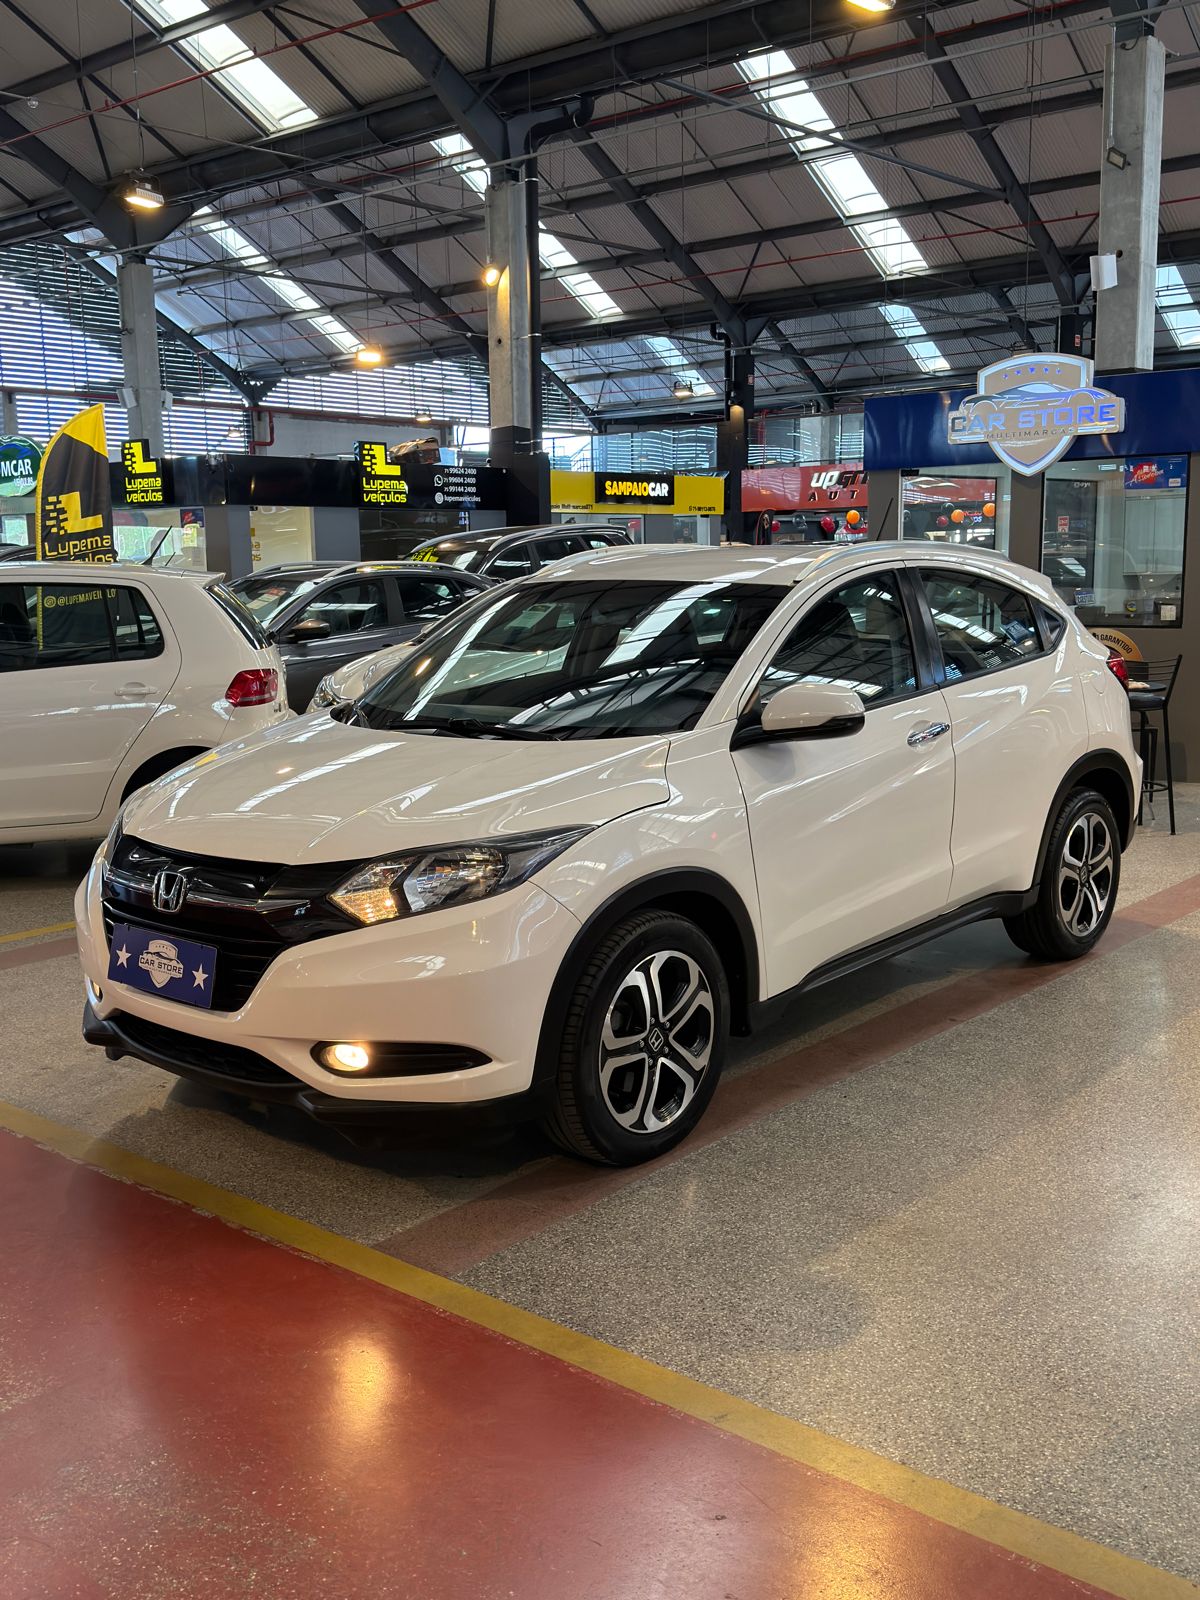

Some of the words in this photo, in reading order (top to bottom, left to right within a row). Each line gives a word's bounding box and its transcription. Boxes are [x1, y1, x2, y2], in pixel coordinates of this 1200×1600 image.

[951, 413, 1006, 433] CAR
[1018, 403, 1117, 429] STORE
[125, 477, 162, 490] Lupema
[362, 477, 406, 492] Lupema
[605, 481, 669, 497] SAMPAIOCAR
[126, 490, 163, 503] veículos
[363, 491, 407, 503] veículos
[44, 535, 112, 557] Lupema
[1100, 633, 1133, 654] GARANTIDO
[140, 957, 155, 967] CAR
[157, 961, 183, 974] STORE
